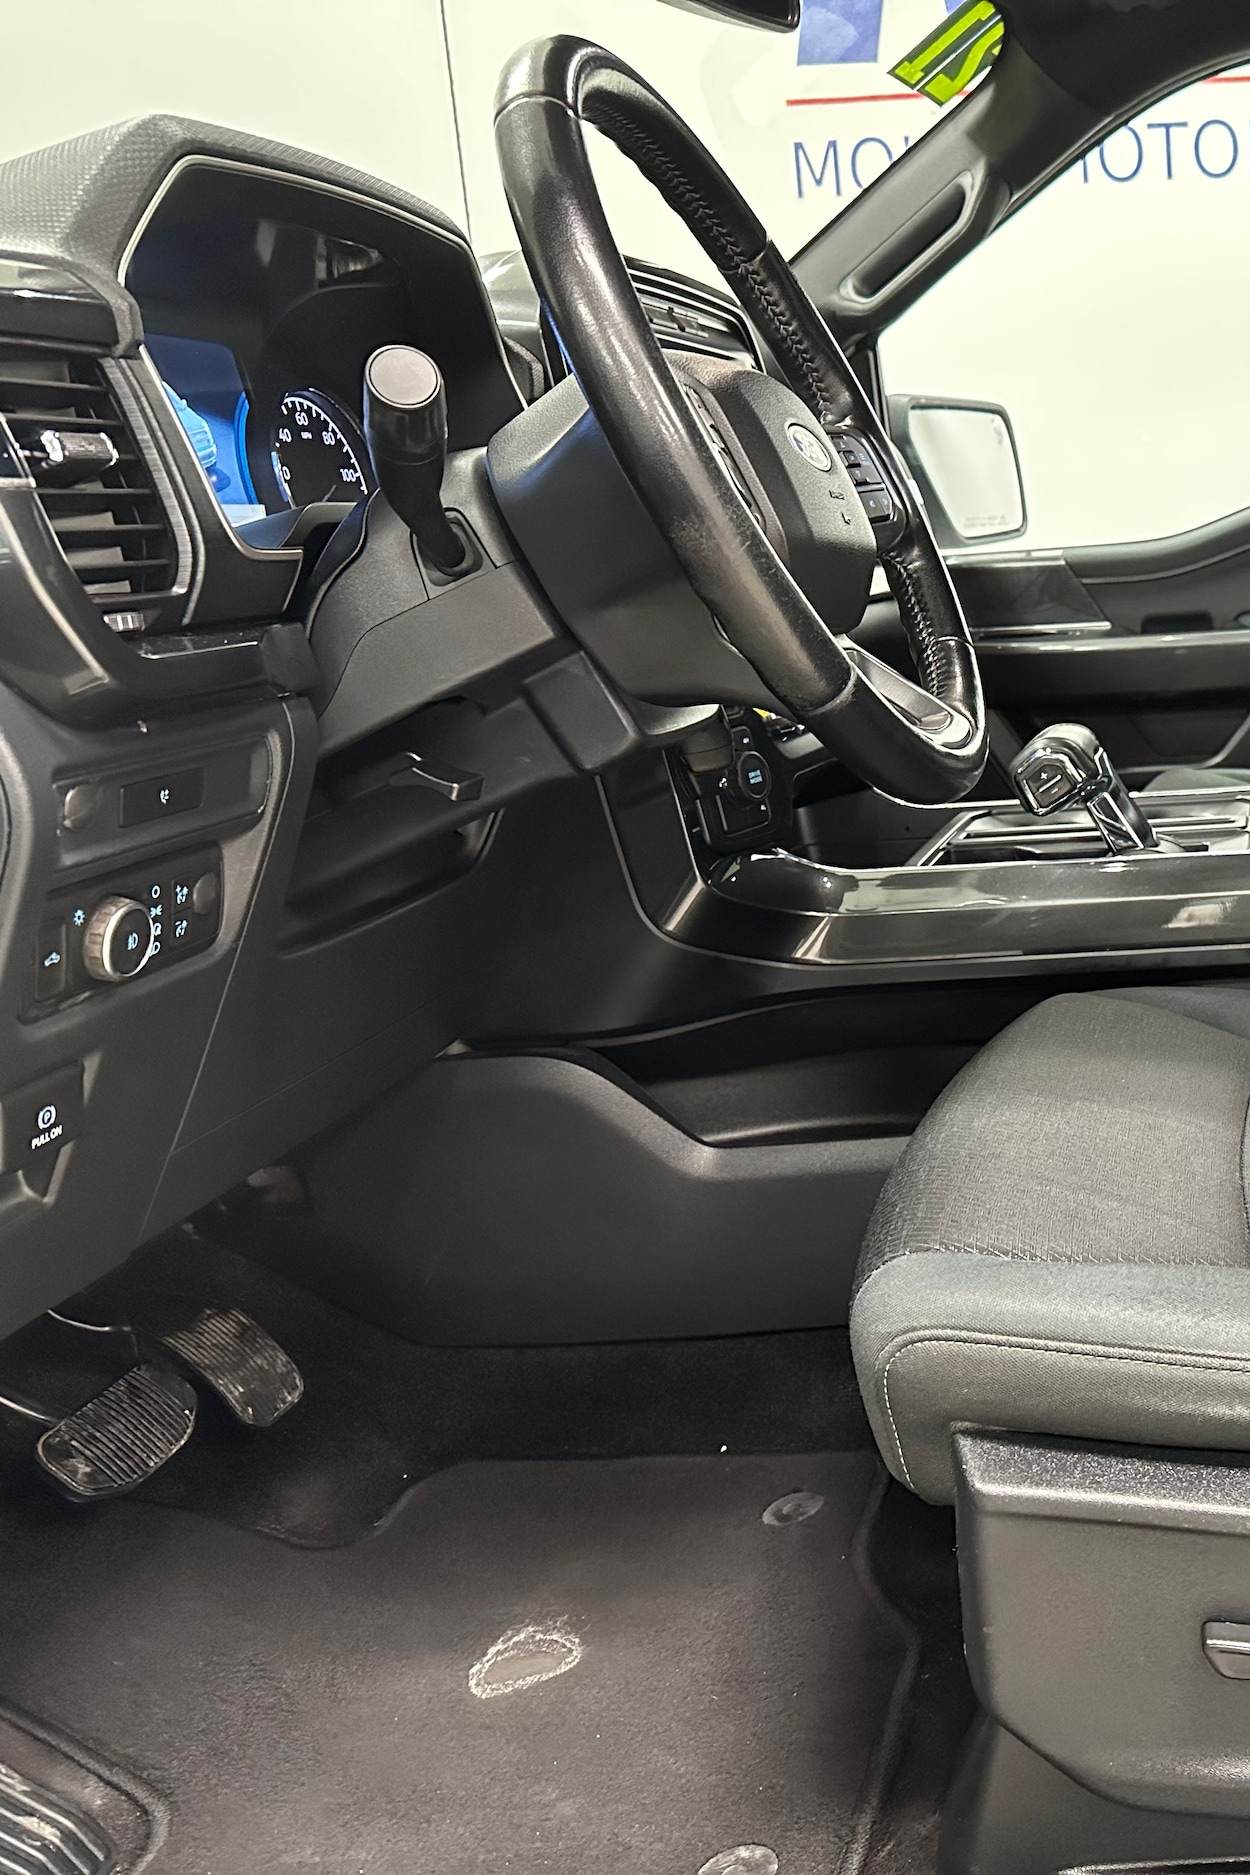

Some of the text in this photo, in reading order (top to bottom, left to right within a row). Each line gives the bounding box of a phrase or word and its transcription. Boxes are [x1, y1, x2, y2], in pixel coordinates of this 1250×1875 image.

[793, 136, 911, 199] MO
[295, 411, 309, 426] 60
[279, 428, 292, 442] 40
[322, 431, 335, 445] 80
[340, 468, 357, 482] 100
[31, 1125, 62, 1149] PULL ON
